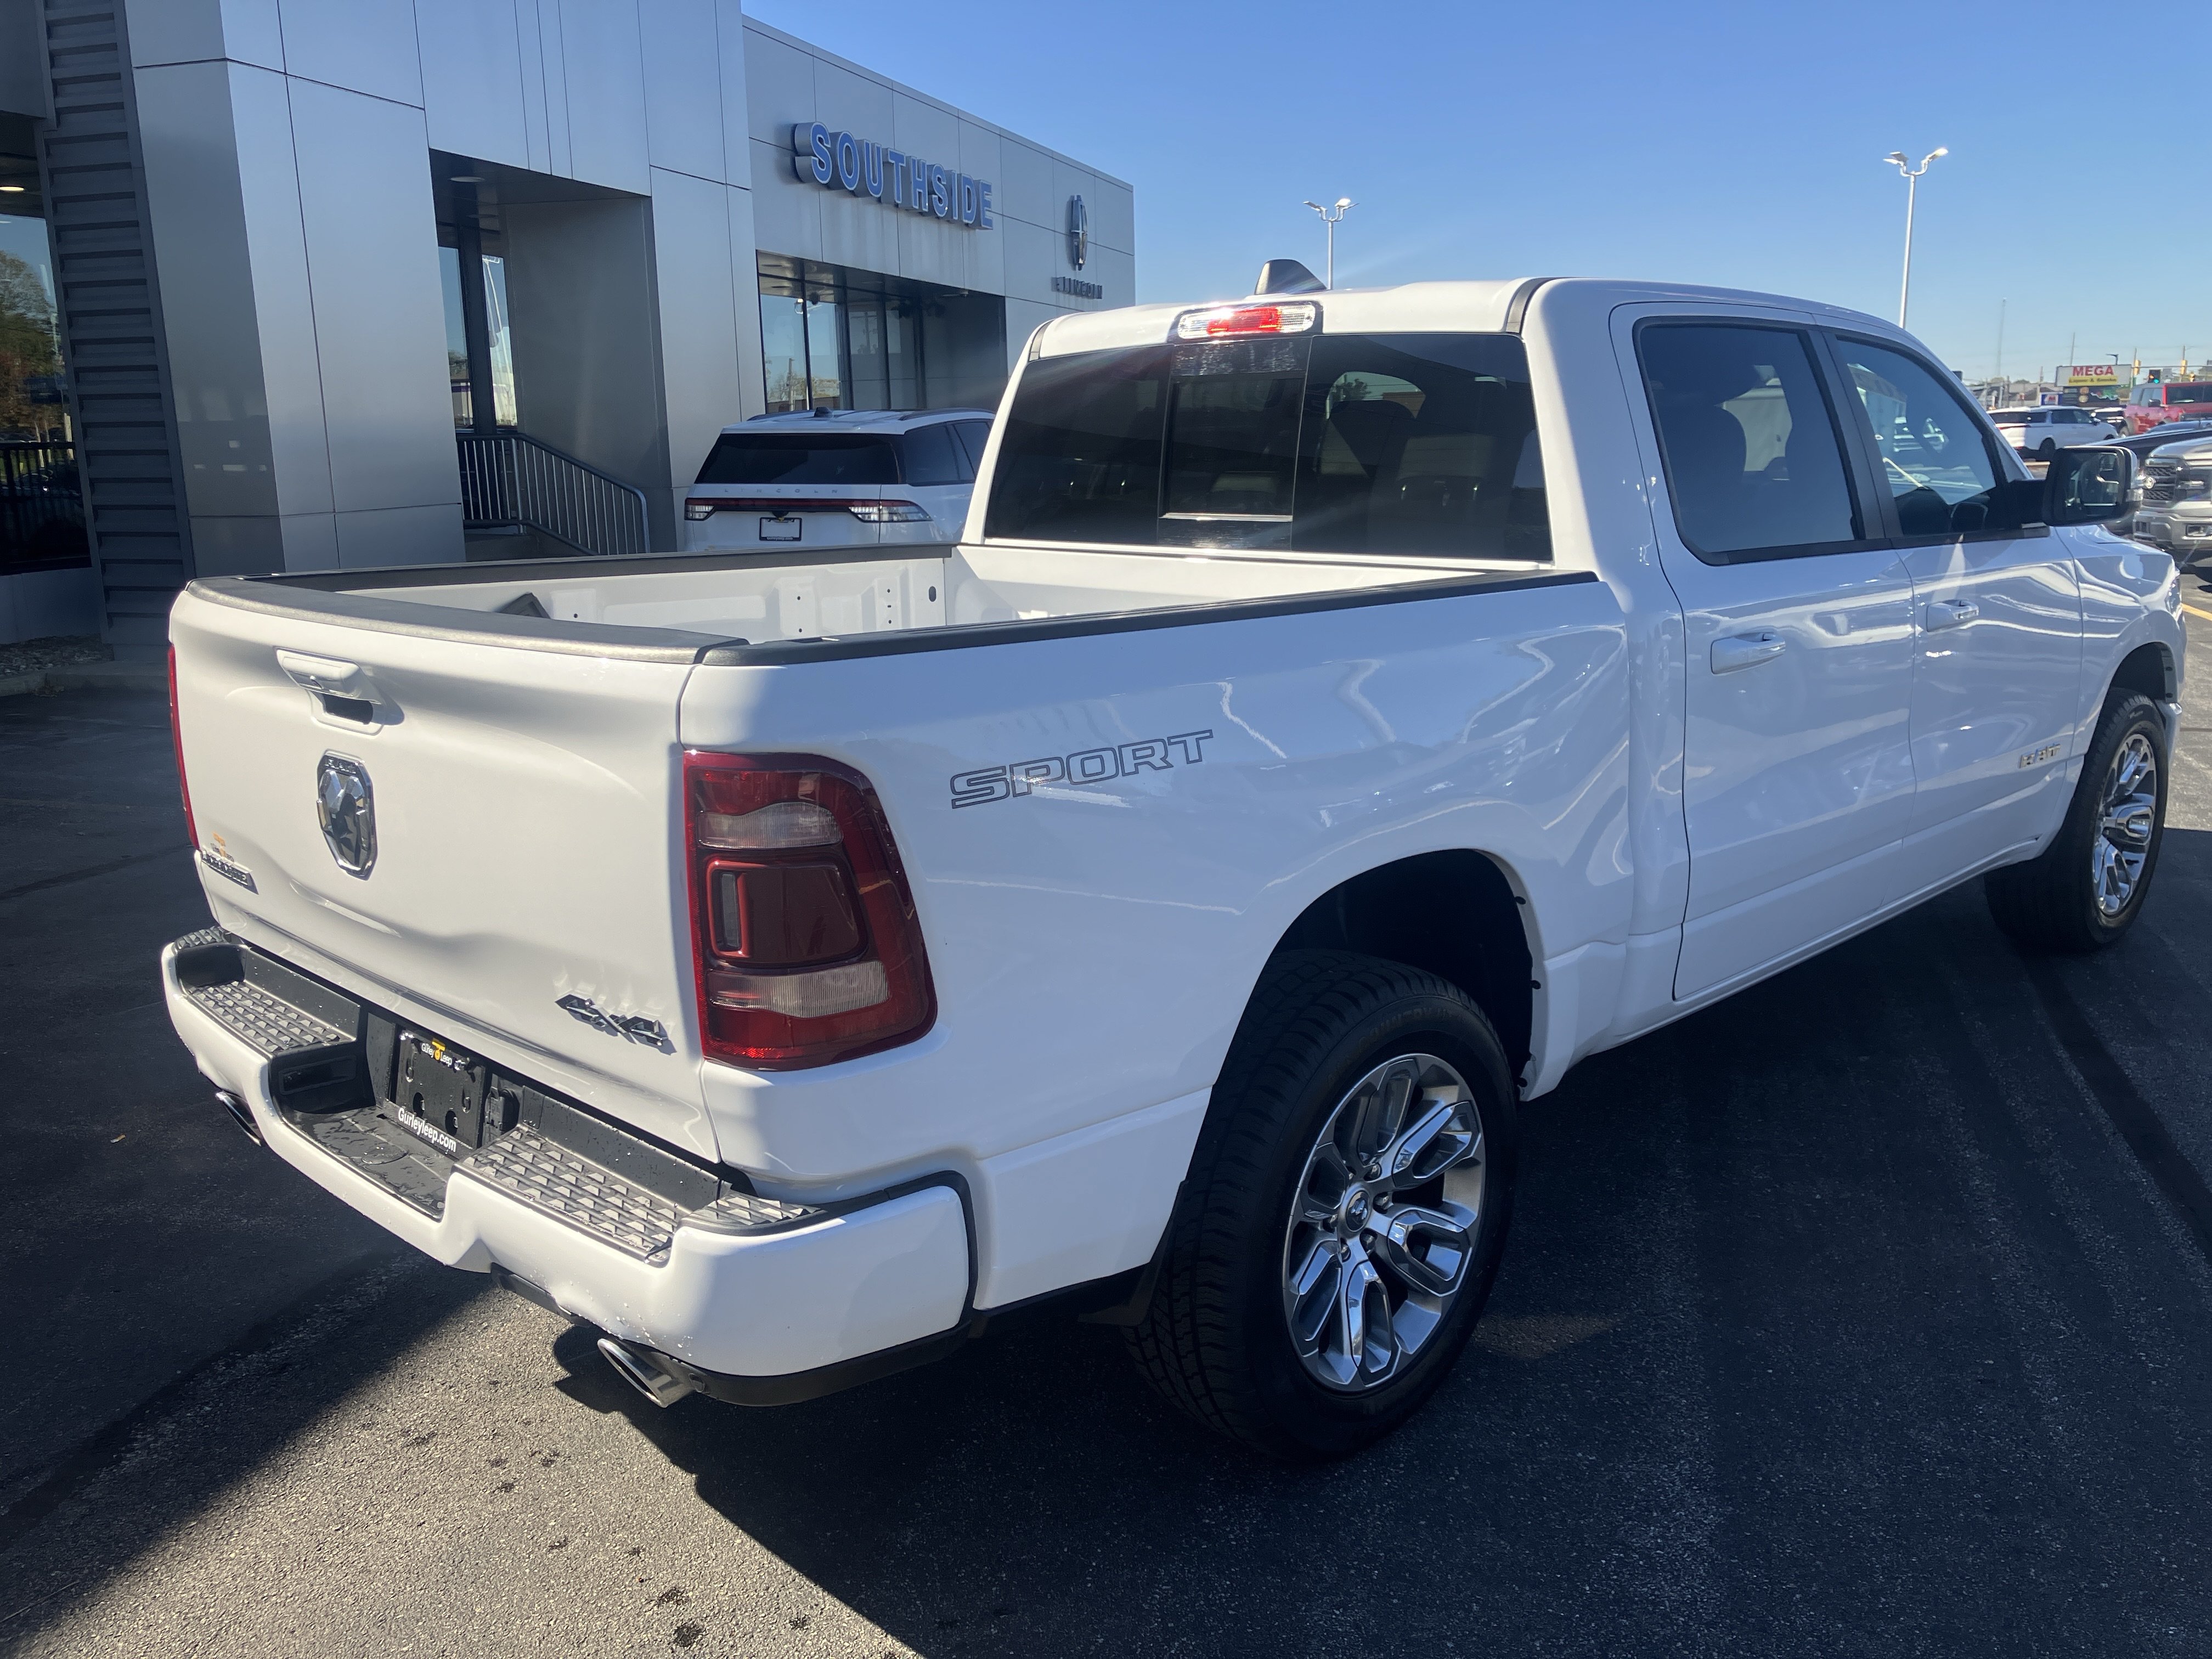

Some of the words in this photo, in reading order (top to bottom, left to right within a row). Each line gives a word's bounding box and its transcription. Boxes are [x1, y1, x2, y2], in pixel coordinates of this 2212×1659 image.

[795, 121, 994, 230] SOUTHSIDE
[2073, 365, 2114, 376] MEGA
[950, 729, 1213, 809] SPORT
[398, 1107, 457, 1153] Gurleyleep.com
